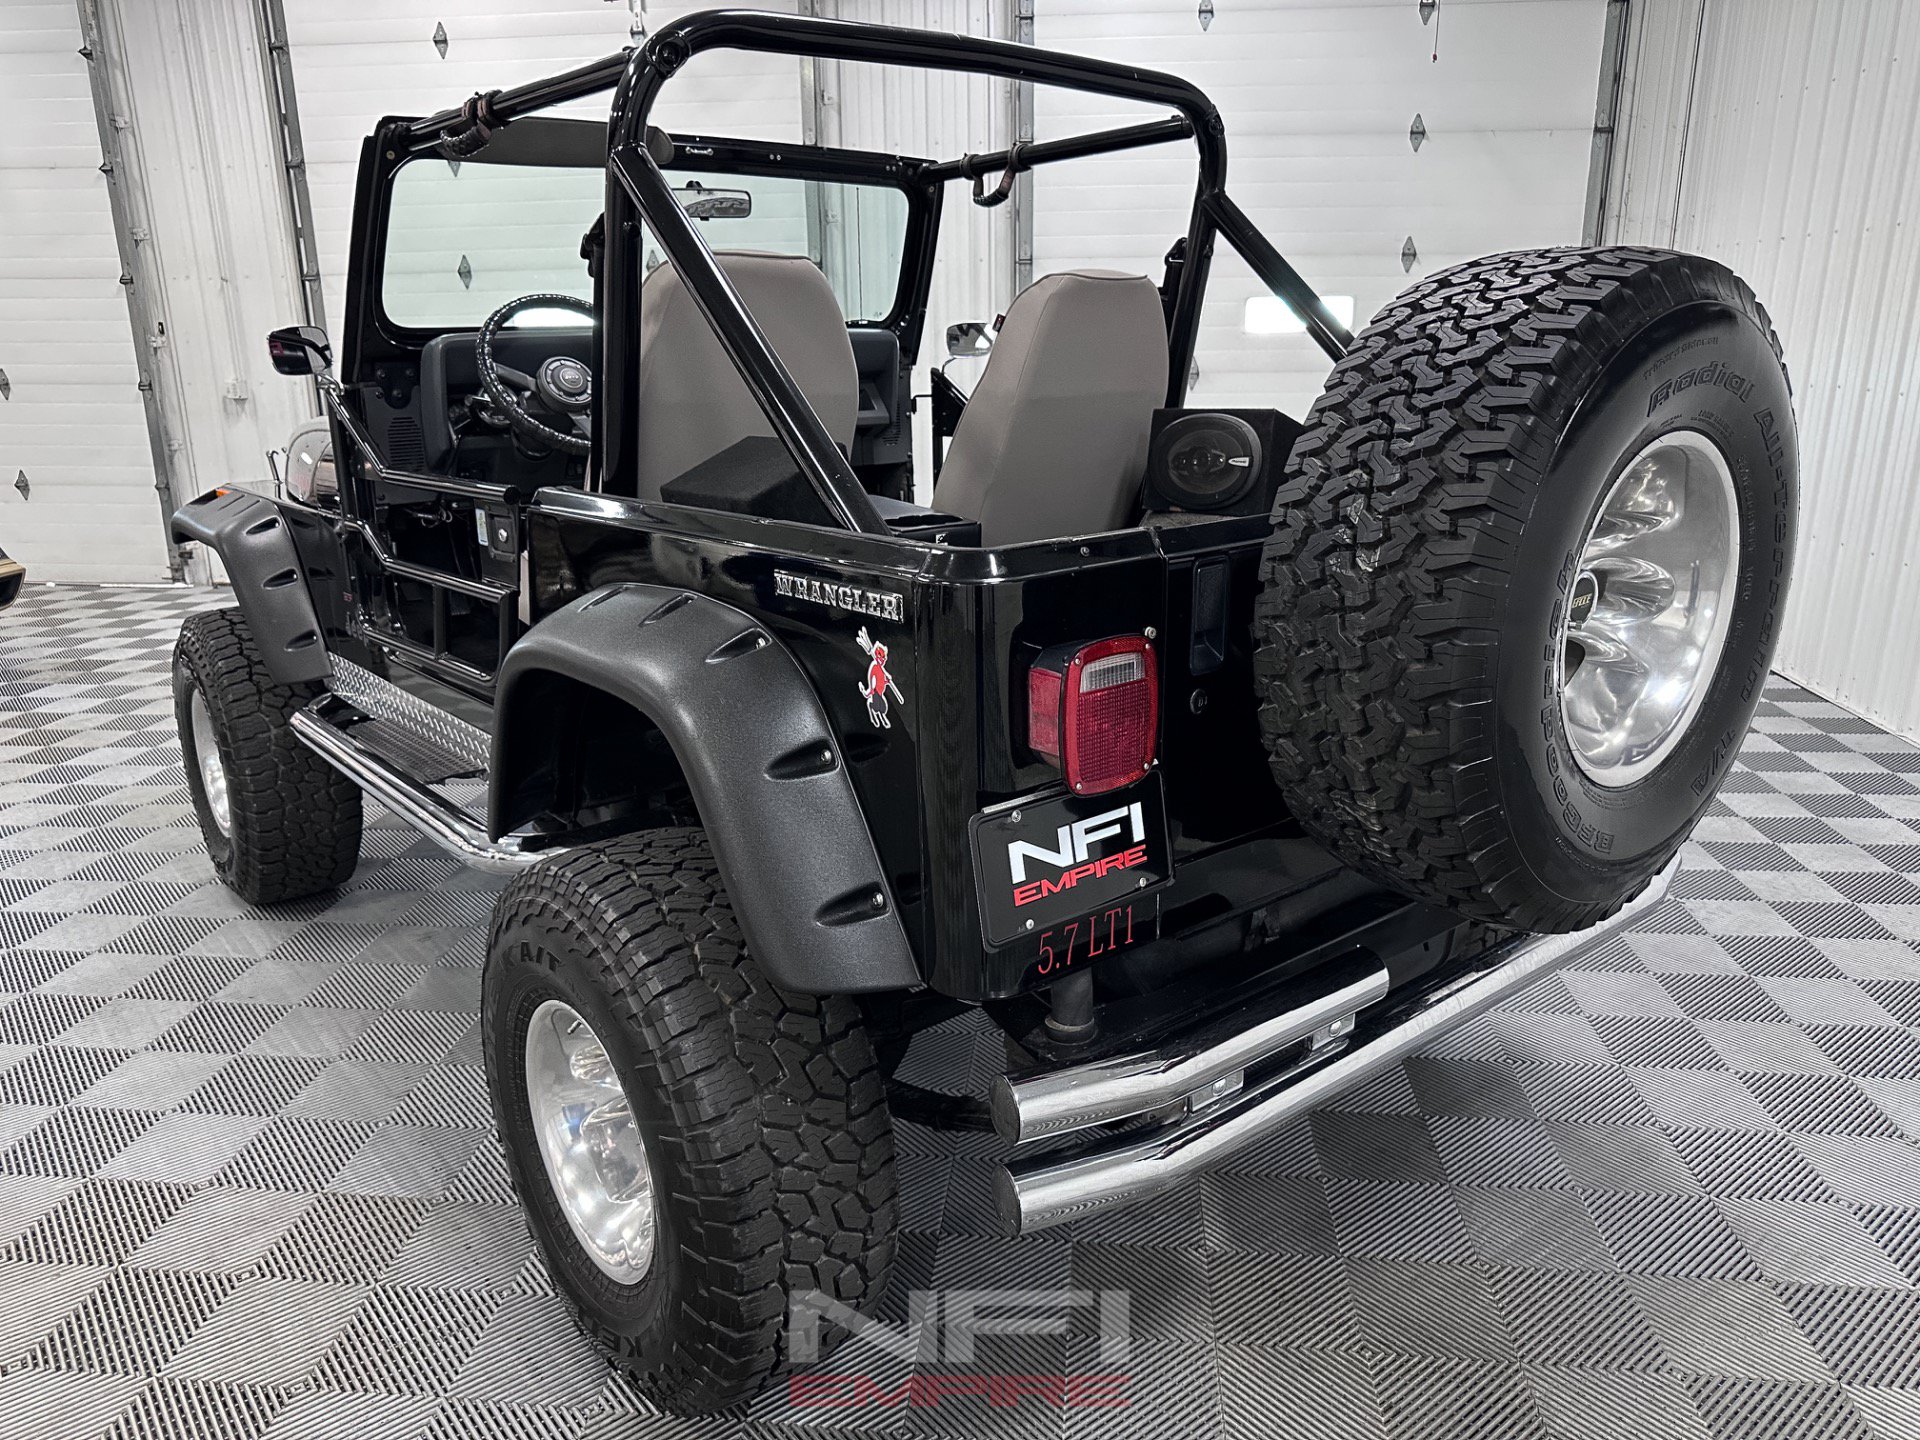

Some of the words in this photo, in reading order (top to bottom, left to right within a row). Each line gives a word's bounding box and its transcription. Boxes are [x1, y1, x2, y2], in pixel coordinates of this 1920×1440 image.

[1646, 360, 1755, 418] Radial
[1741, 406, 1788, 703] All-Terrain
[774, 571, 903, 622] WRANGLER
[1007, 801, 1146, 885] NFI
[1013, 844, 1148, 907] EMPIRE
[1038, 922, 1079, 975] 5.7
[1088, 905, 1134, 957] LT1
